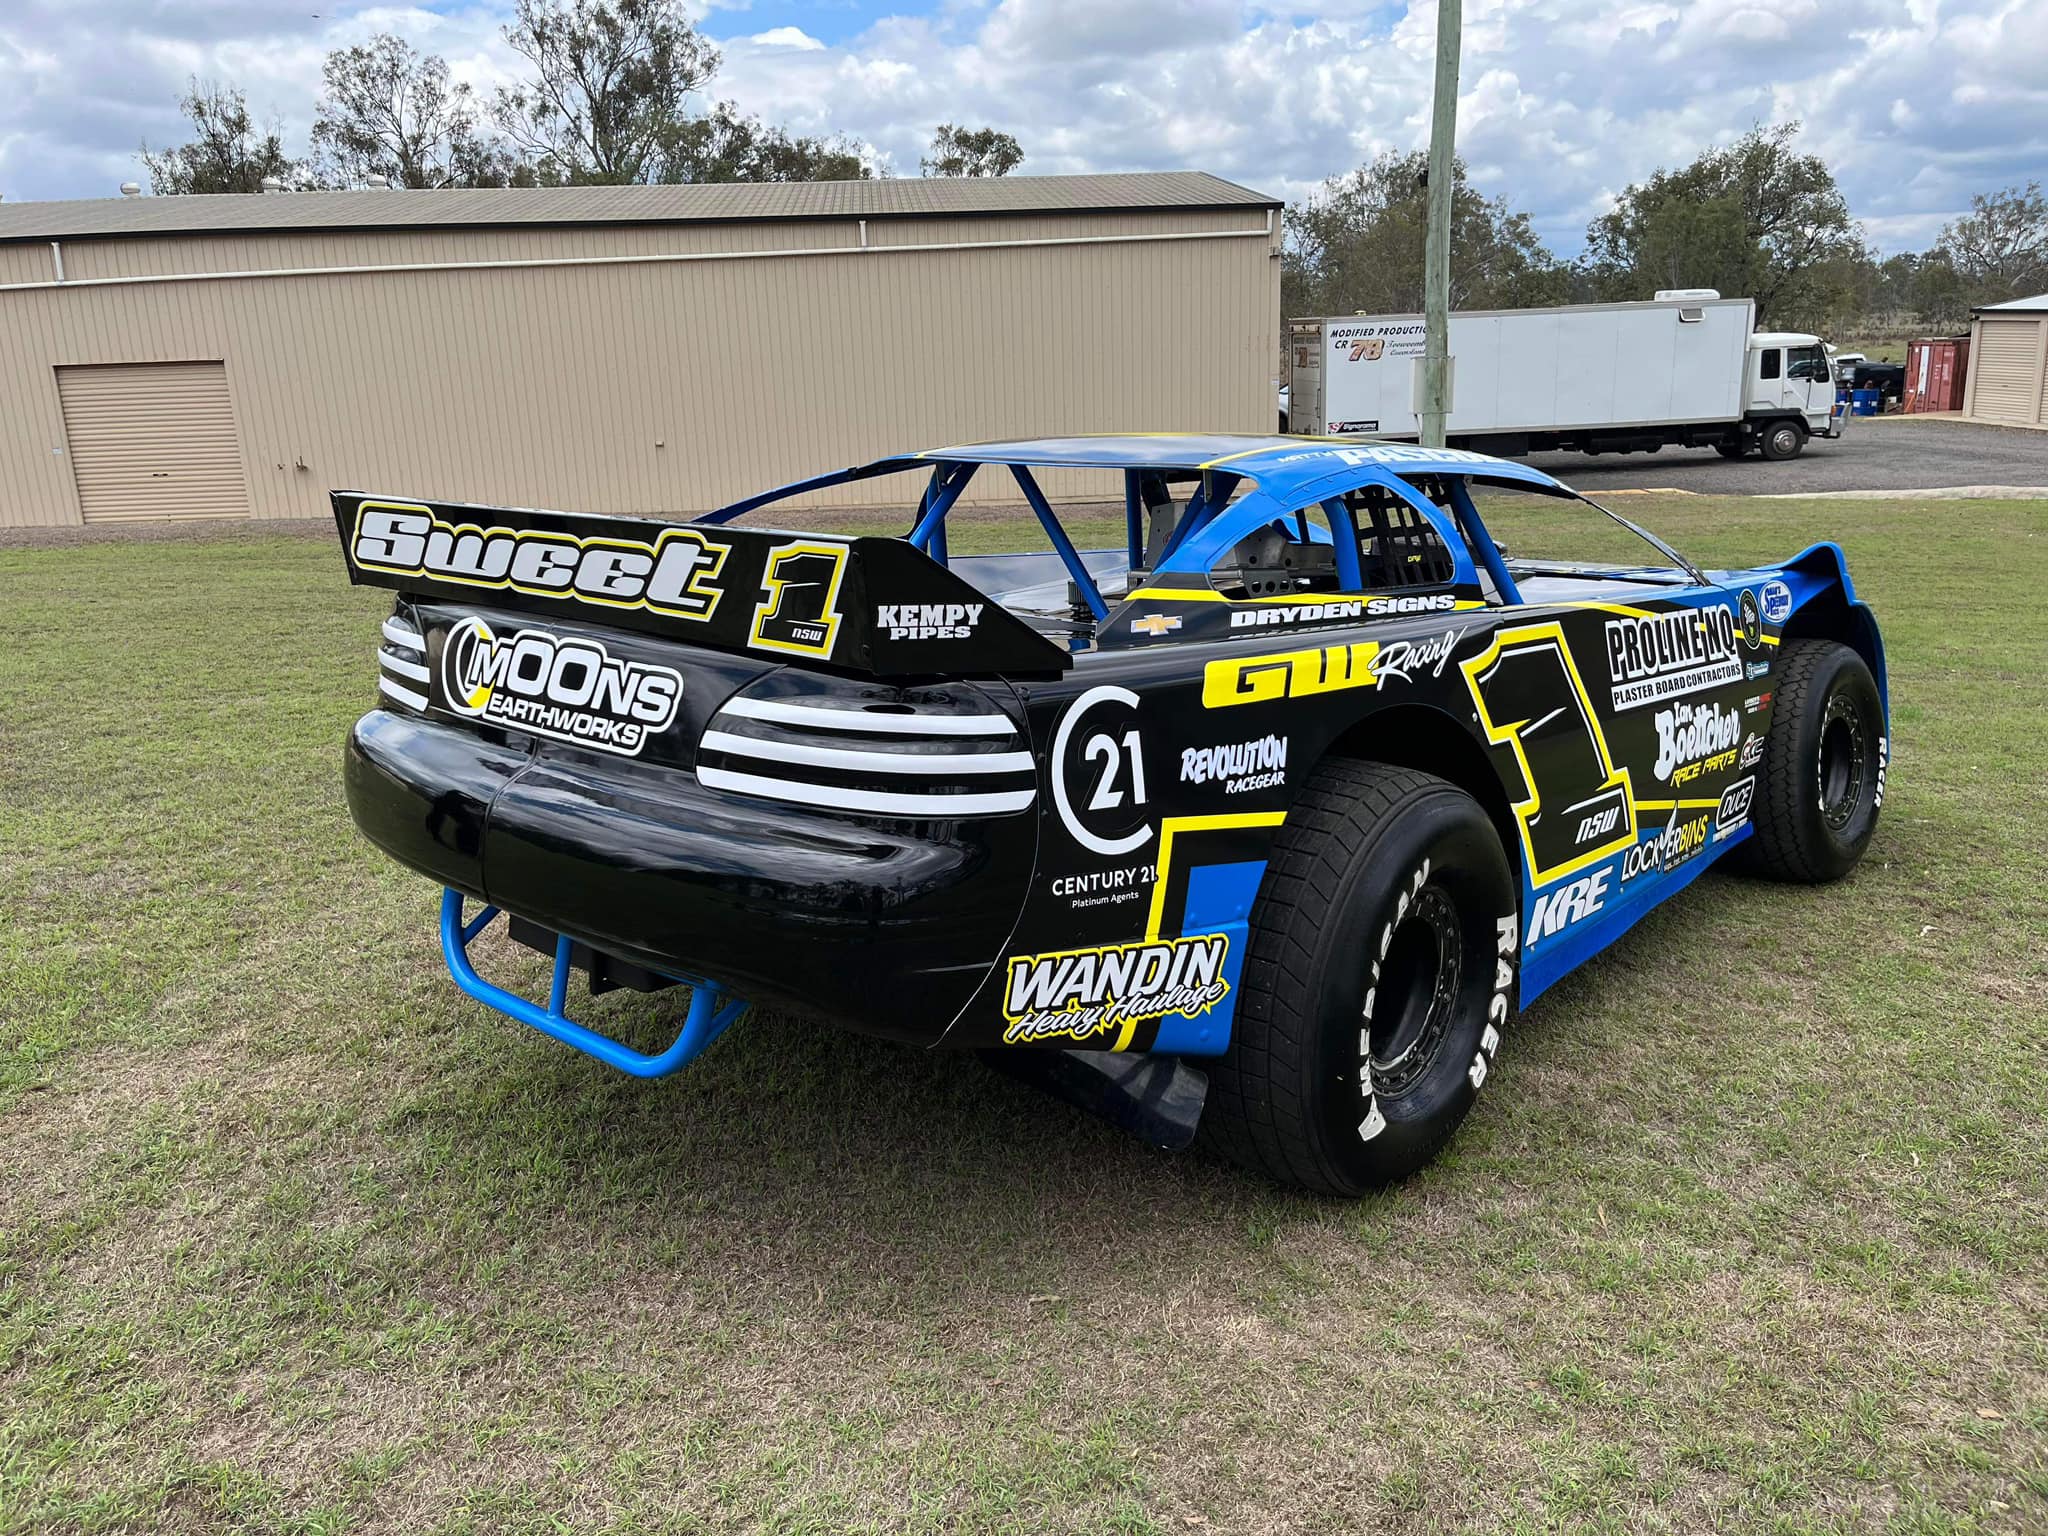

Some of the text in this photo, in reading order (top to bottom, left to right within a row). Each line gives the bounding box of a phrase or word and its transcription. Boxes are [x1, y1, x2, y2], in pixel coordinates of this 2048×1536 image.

[1330, 328, 1375, 338] MODIFIED
[1334, 340, 1348, 349] CR
[1348, 338, 1385, 361] 78
[354, 505, 850, 661] Sweet 1
[877, 604, 984, 628] KEMPY
[890, 625, 971, 640] PIPES
[1230, 595, 1456, 627] DRYDEN SIGNS
[1606, 611, 1704, 678] PROLINE
[1703, 606, 1738, 657] NQ
[469, 639, 679, 723] MOONS
[1203, 626, 1467, 708] GW Racing
[1614, 684, 1655, 705] PLASTER
[1656, 677, 1686, 697] BOARD
[1687, 663, 1741, 688] CONTRACTORS
[488, 695, 643, 747] EARTHWORKS
[1674, 701, 1694, 727] Ian
[1180, 734, 1287, 785] REVOLUTION
[1654, 702, 1740, 781] Boettcher
[1225, 772, 1285, 794] RACEGEAR
[1670, 762, 1702, 788] RACE
[1702, 749, 1738, 774] PARTS
[1873, 737, 1888, 808] RACER
[1720, 785, 1752, 819] DUCE
[1052, 868, 1137, 896] CENTURY
[1071, 891, 1140, 908] Platinum Agents
[1525, 865, 1614, 947] KRE
[1009, 938, 1223, 1012] WANDIN
[1006, 981, 1224, 1037] Heavy Haulage
[1468, 912, 1518, 1089] RACER
